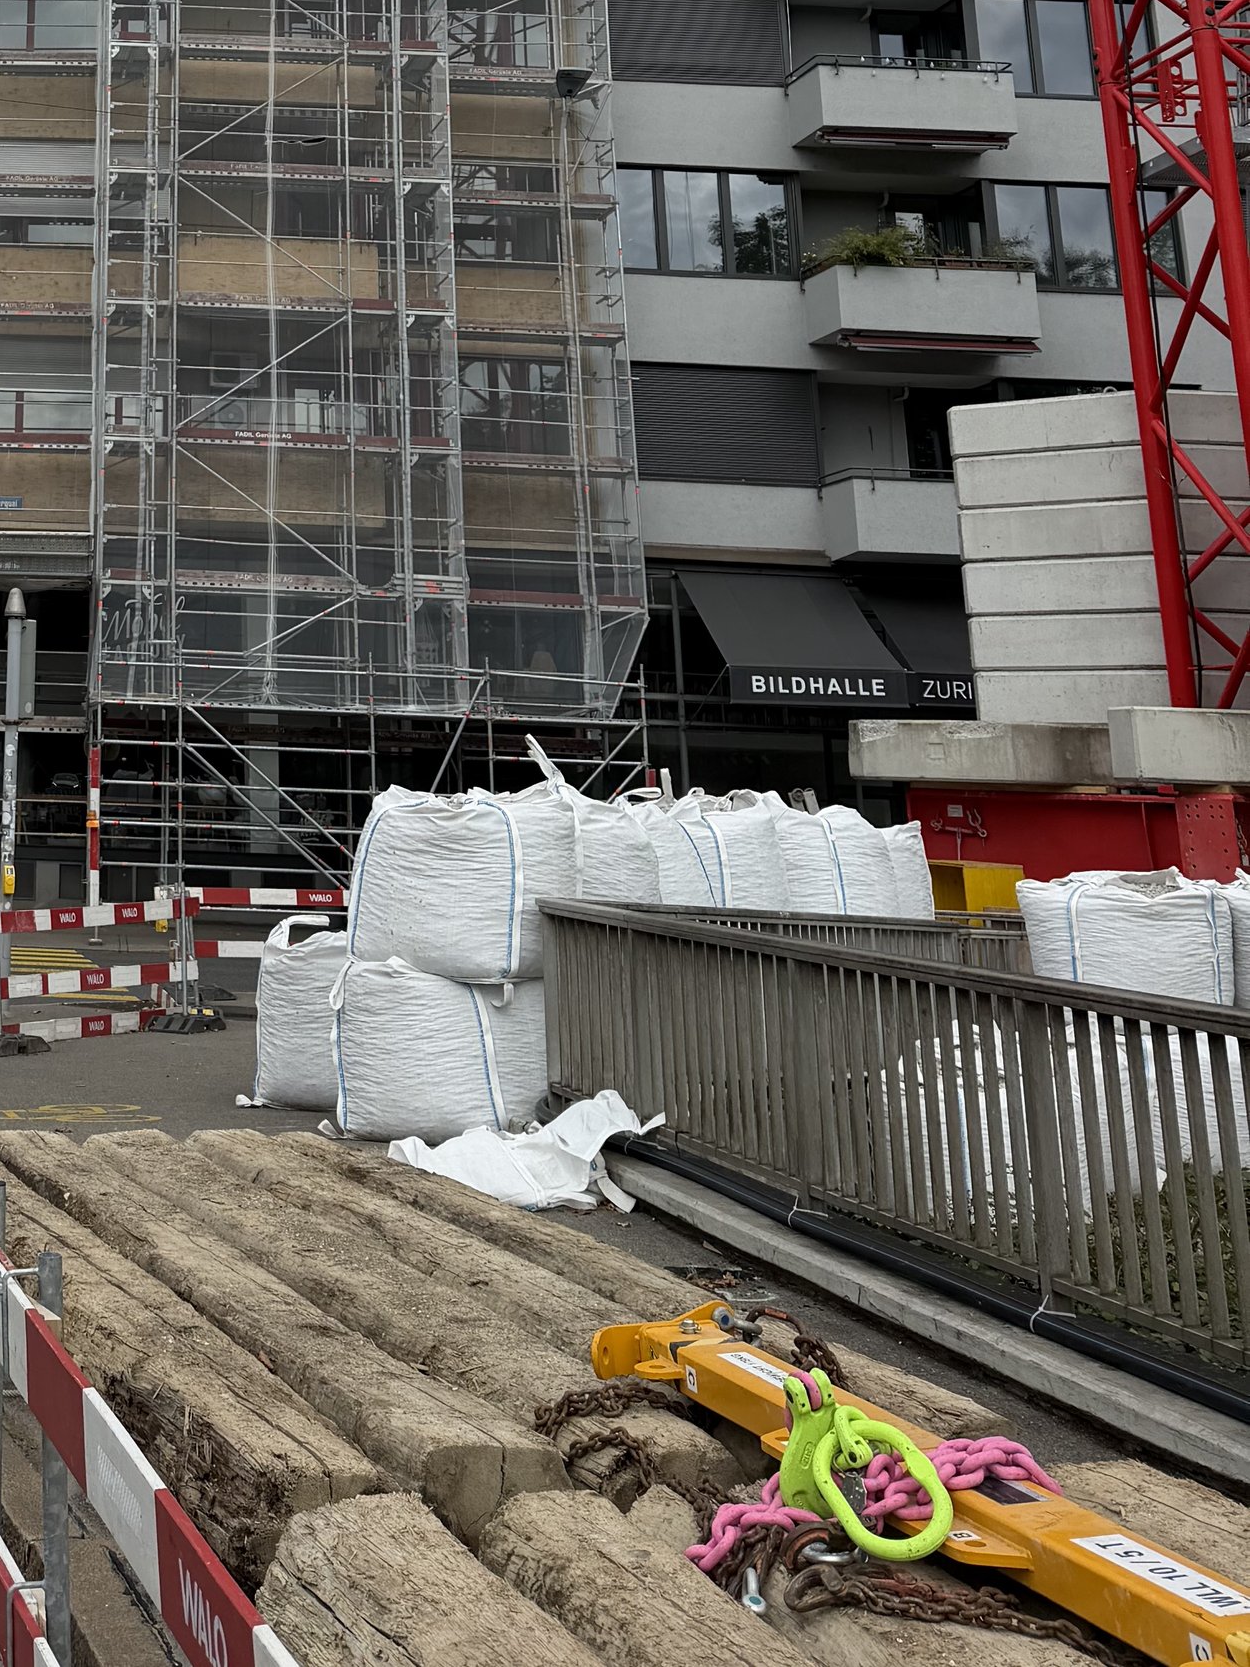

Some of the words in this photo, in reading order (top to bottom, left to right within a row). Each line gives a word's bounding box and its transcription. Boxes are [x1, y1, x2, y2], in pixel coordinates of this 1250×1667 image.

[751, 675, 886, 696] BILDHALLE
[922, 680, 973, 700] ZURI
[308, 893, 333, 902] WALO
[58, 912, 76, 924] WALO
[121, 907, 138, 918] WALO
[86, 972, 105, 984] WALO
[88, 1019, 105, 1032] WALO
[1095, 1542, 1124, 1550] T
[1115, 1550, 1144, 1558] 5
[1148, 1567, 1189, 1581] 10
[1183, 1582, 1243, 1608] WLL
[178, 1557, 228, 1667] WALO
